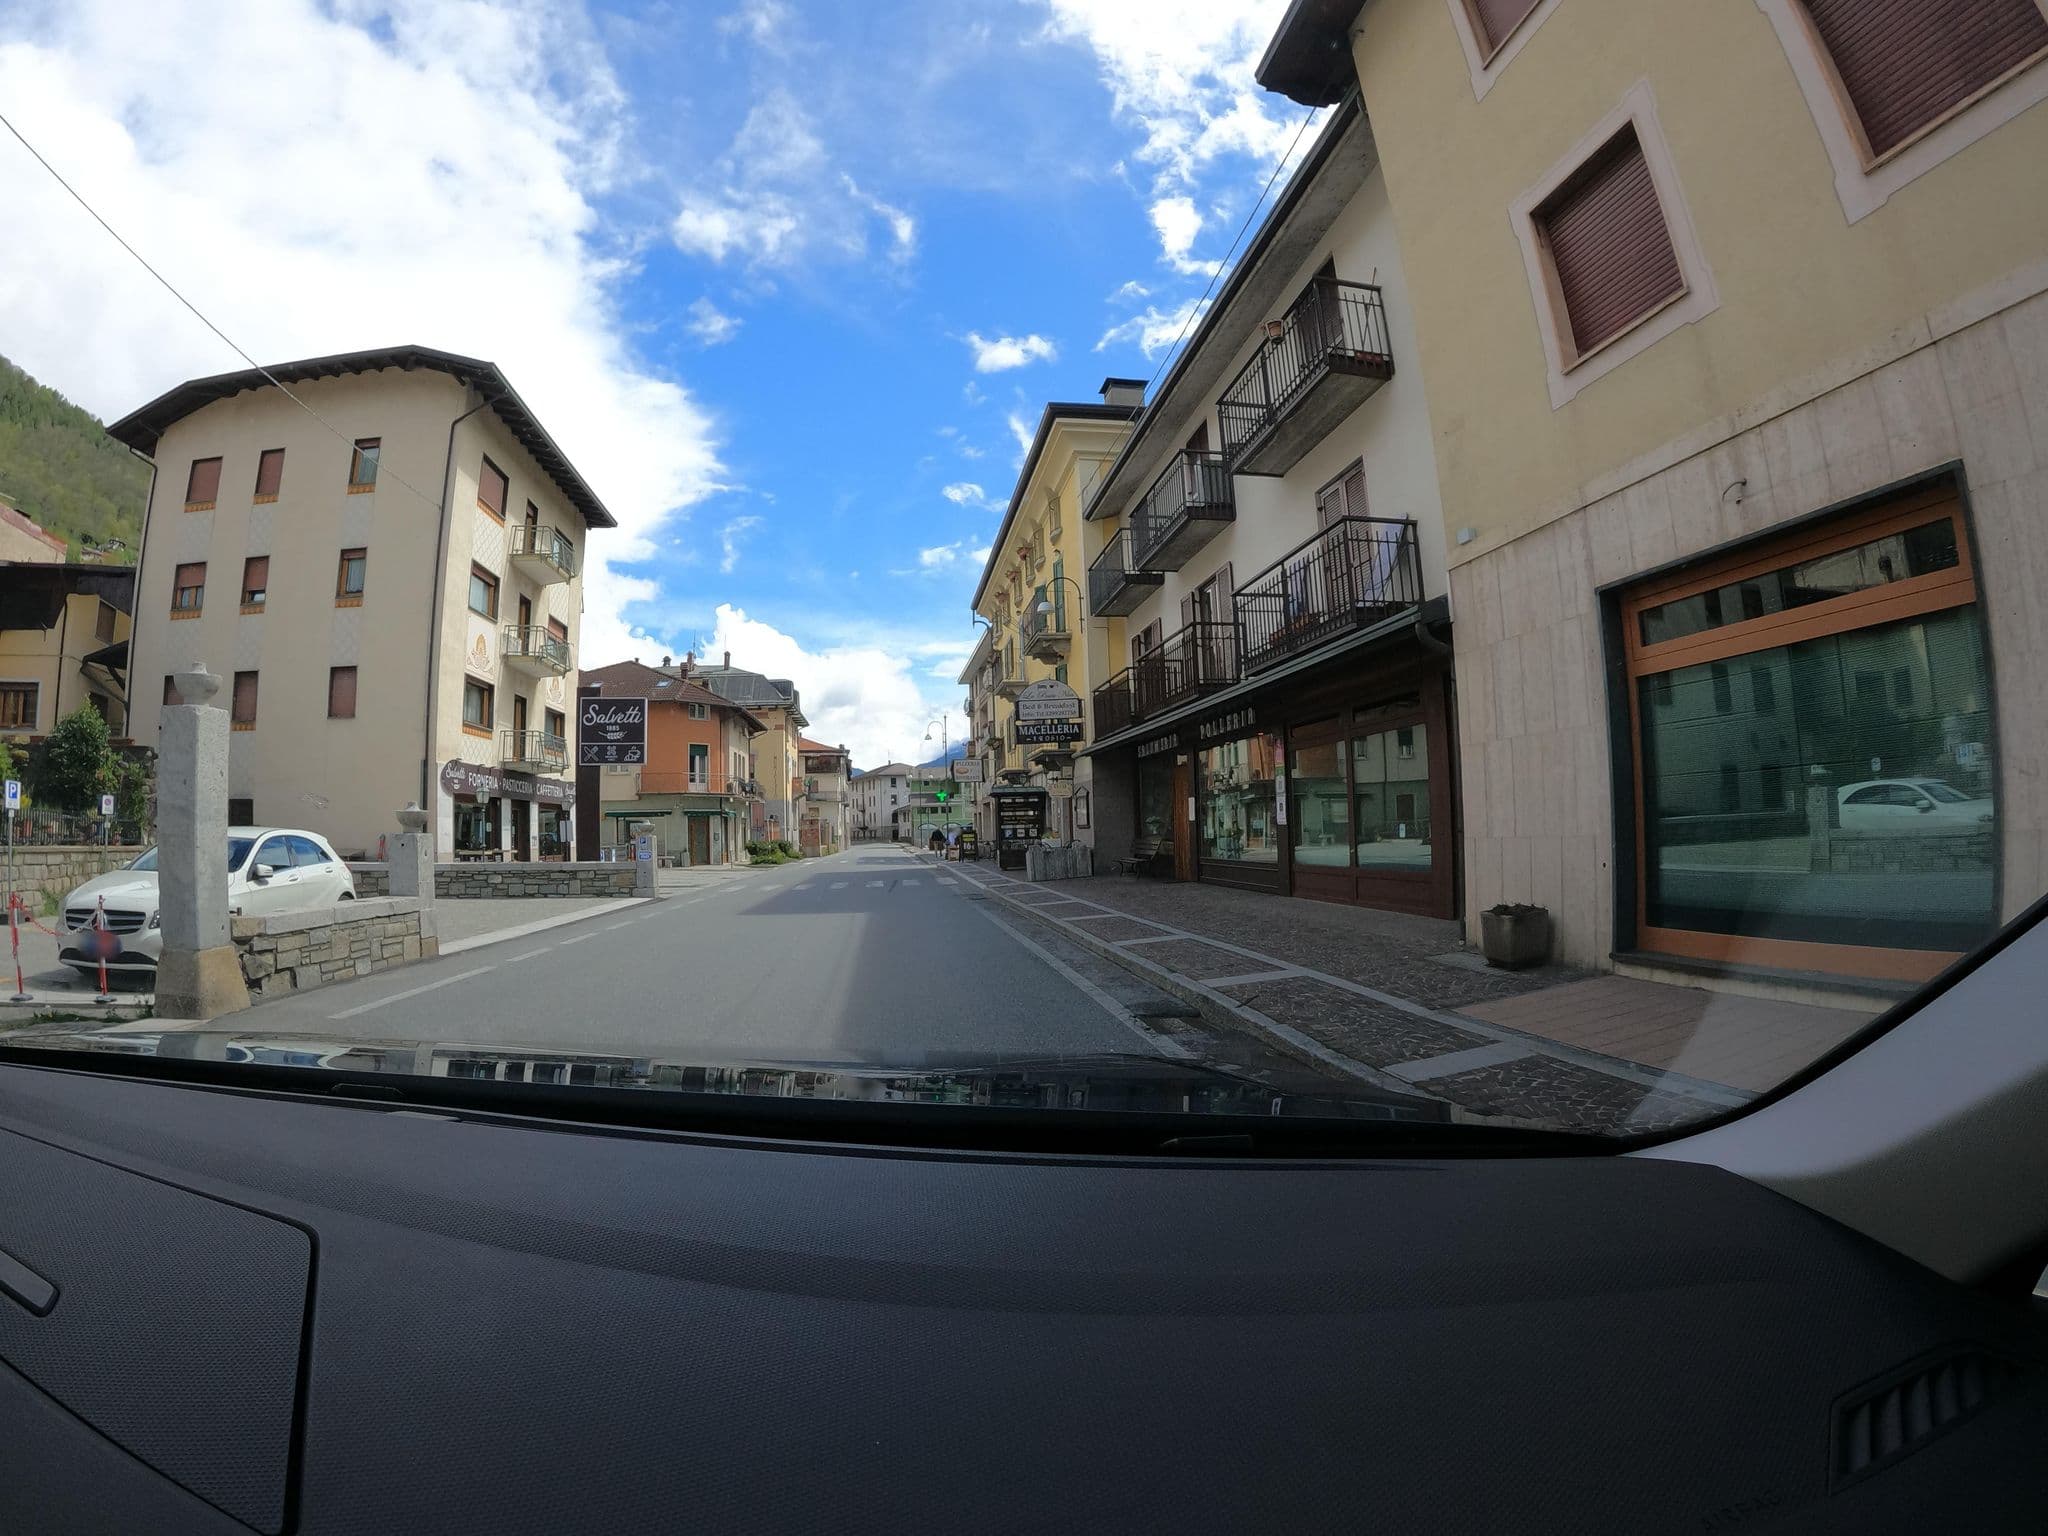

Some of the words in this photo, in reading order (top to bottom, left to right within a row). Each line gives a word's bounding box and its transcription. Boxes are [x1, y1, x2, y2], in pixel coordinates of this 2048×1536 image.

[583, 704, 643, 726] Salvetti
[1200, 708, 1256, 739] POLLERIA
[1019, 724, 1079, 735] MACELLERIA
[1137, 733, 1179, 758] SALUMERIA
[468, 772, 499, 789] FORNERIA
[502, 777, 534, 794] PASTICCERIA
